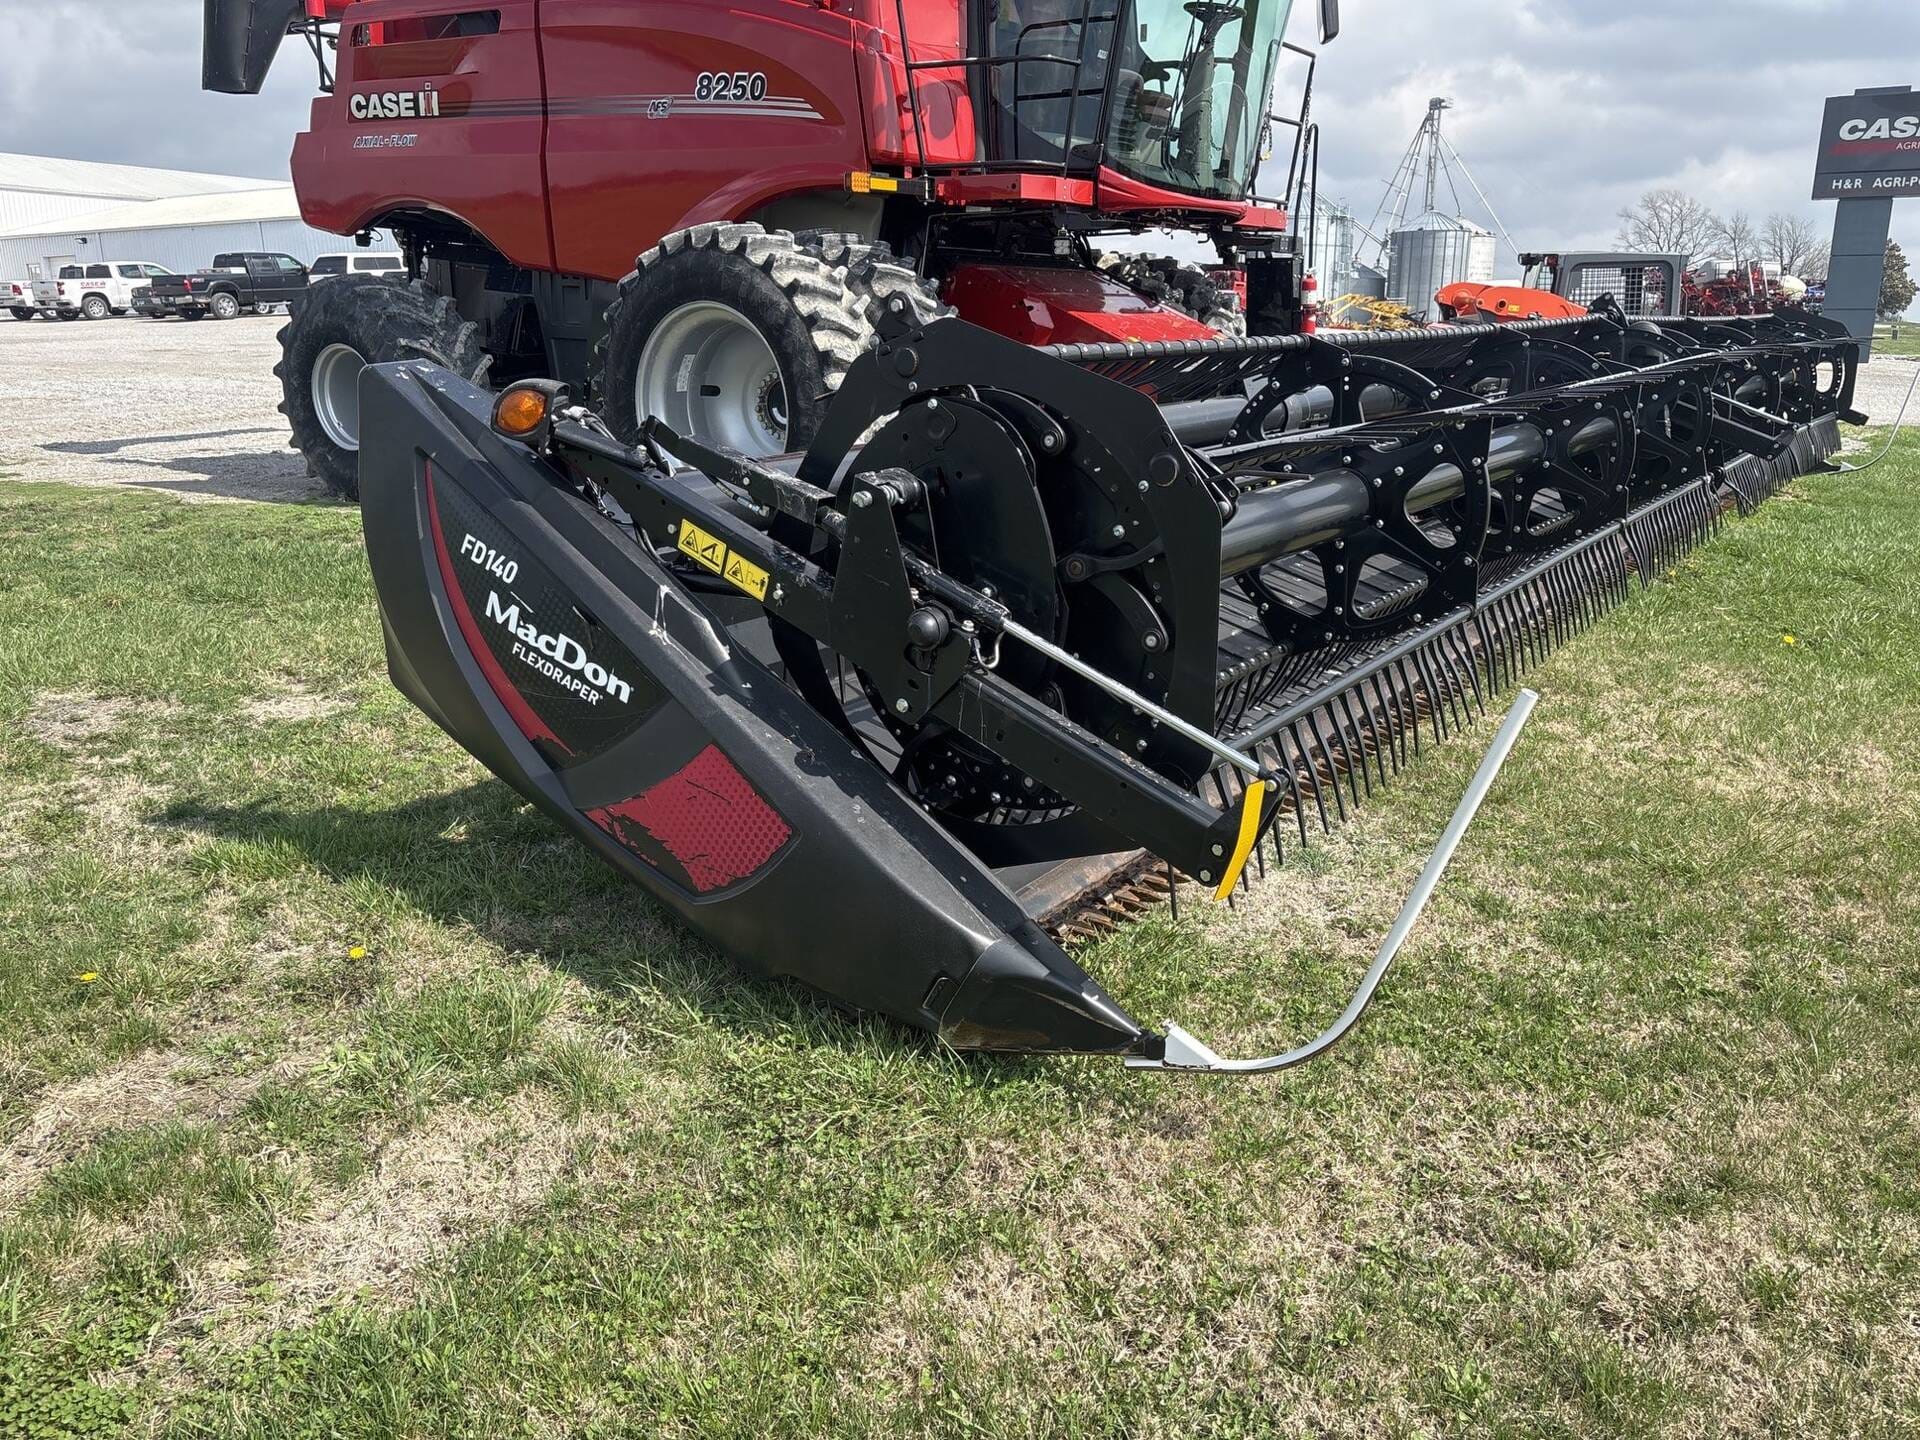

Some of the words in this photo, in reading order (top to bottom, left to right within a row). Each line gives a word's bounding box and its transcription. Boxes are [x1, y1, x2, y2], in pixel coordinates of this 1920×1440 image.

[695, 71, 767, 102] 8250
[350, 92, 415, 119] CASE
[353, 134, 418, 149] AXIAL-FLOW
[1839, 116, 1920, 141] CAS
[1832, 178, 1863, 190] H&R
[1872, 176, 1920, 188] AGRI-P
[460, 533, 519, 584] FD140
[485, 590, 631, 704] MacDon
[512, 642, 600, 706] FLEXDRAPER
